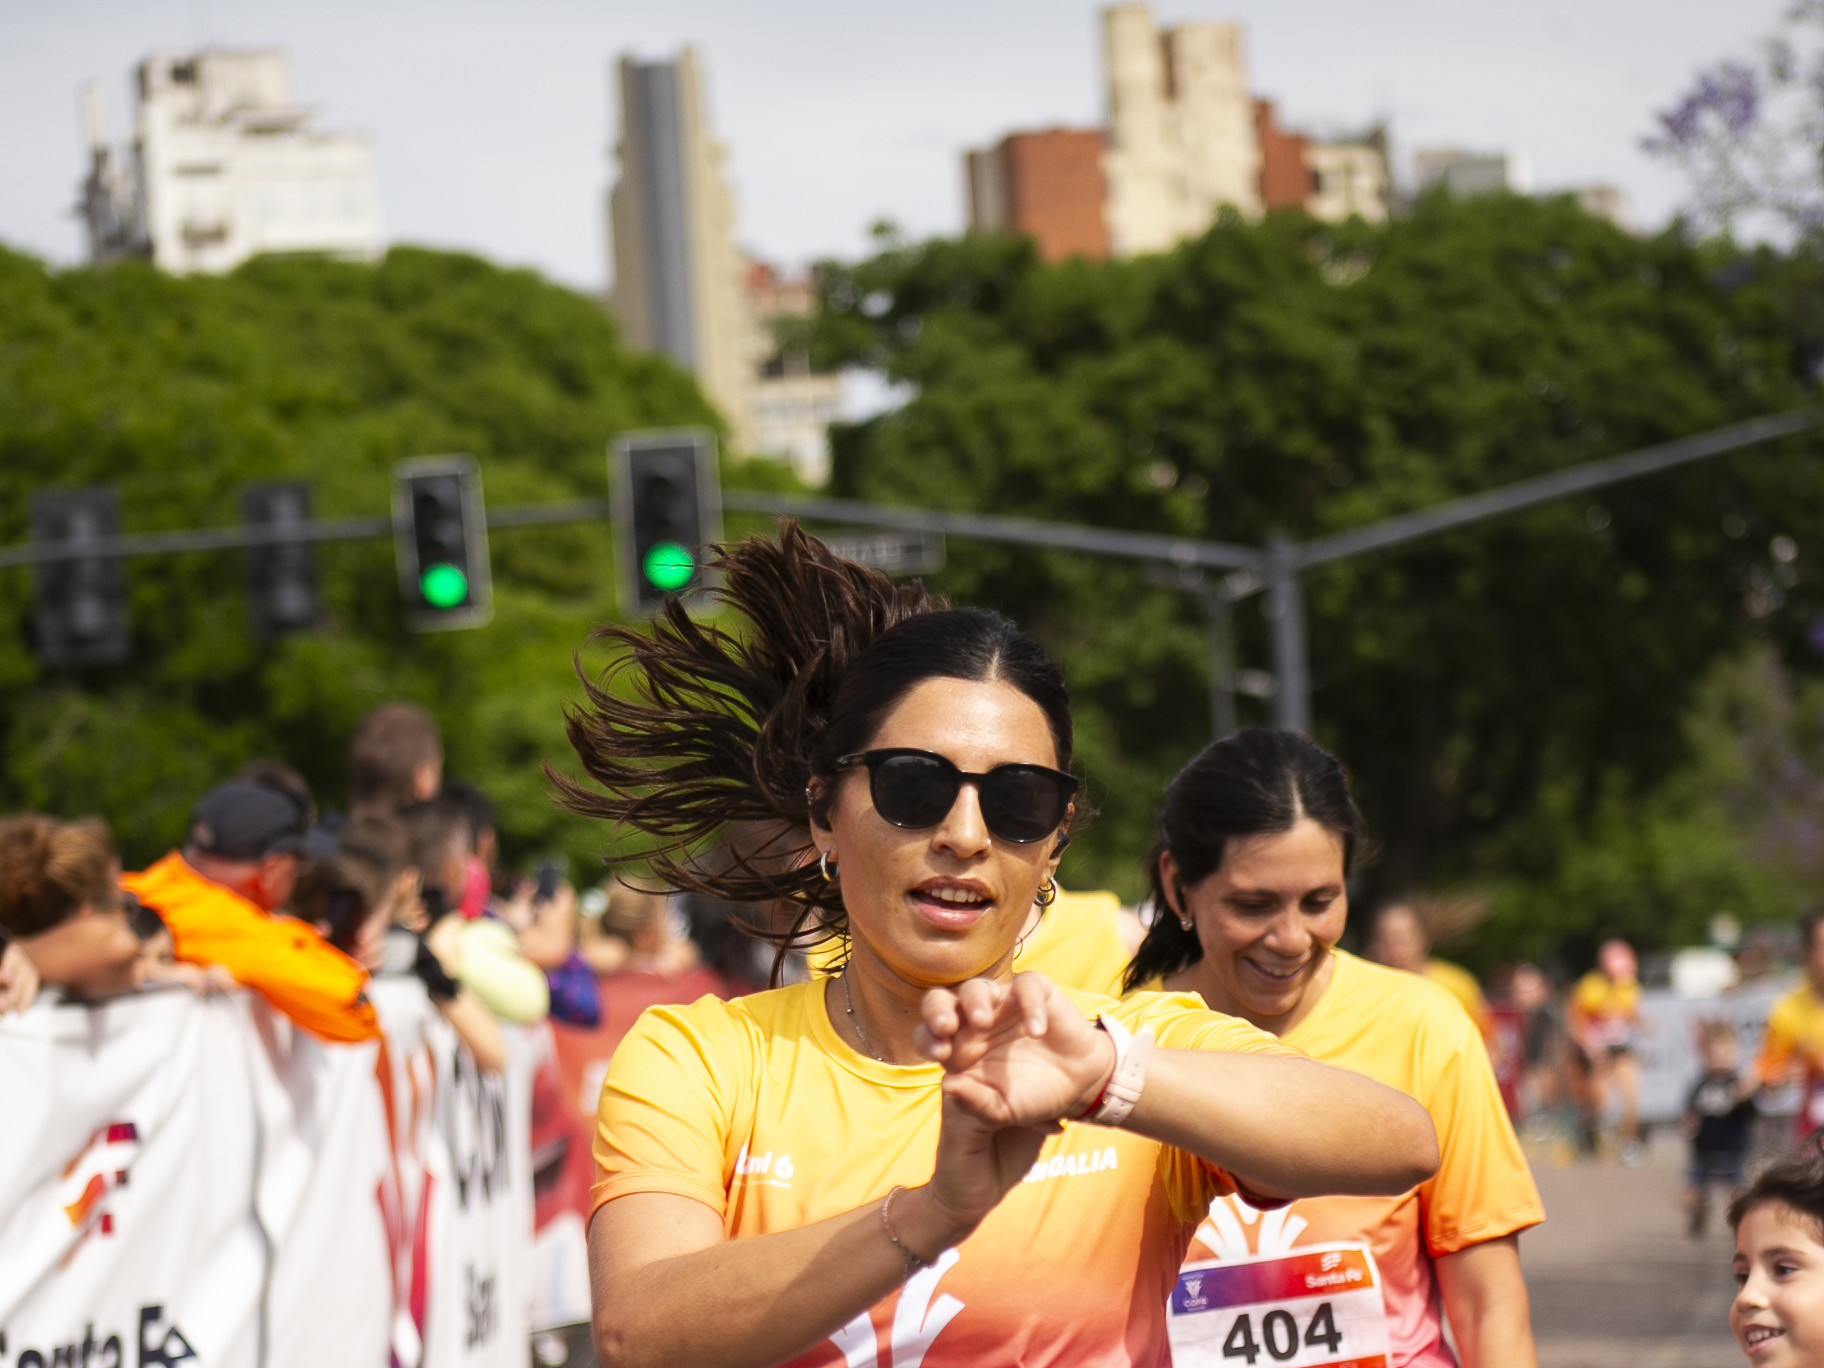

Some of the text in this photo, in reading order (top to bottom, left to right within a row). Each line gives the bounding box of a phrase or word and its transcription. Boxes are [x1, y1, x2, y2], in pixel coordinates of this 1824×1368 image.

[1022, 1147, 1117, 1182] NDALIA
[1305, 1271, 1345, 1288] Santa
[1222, 1302, 1342, 1366] 404
